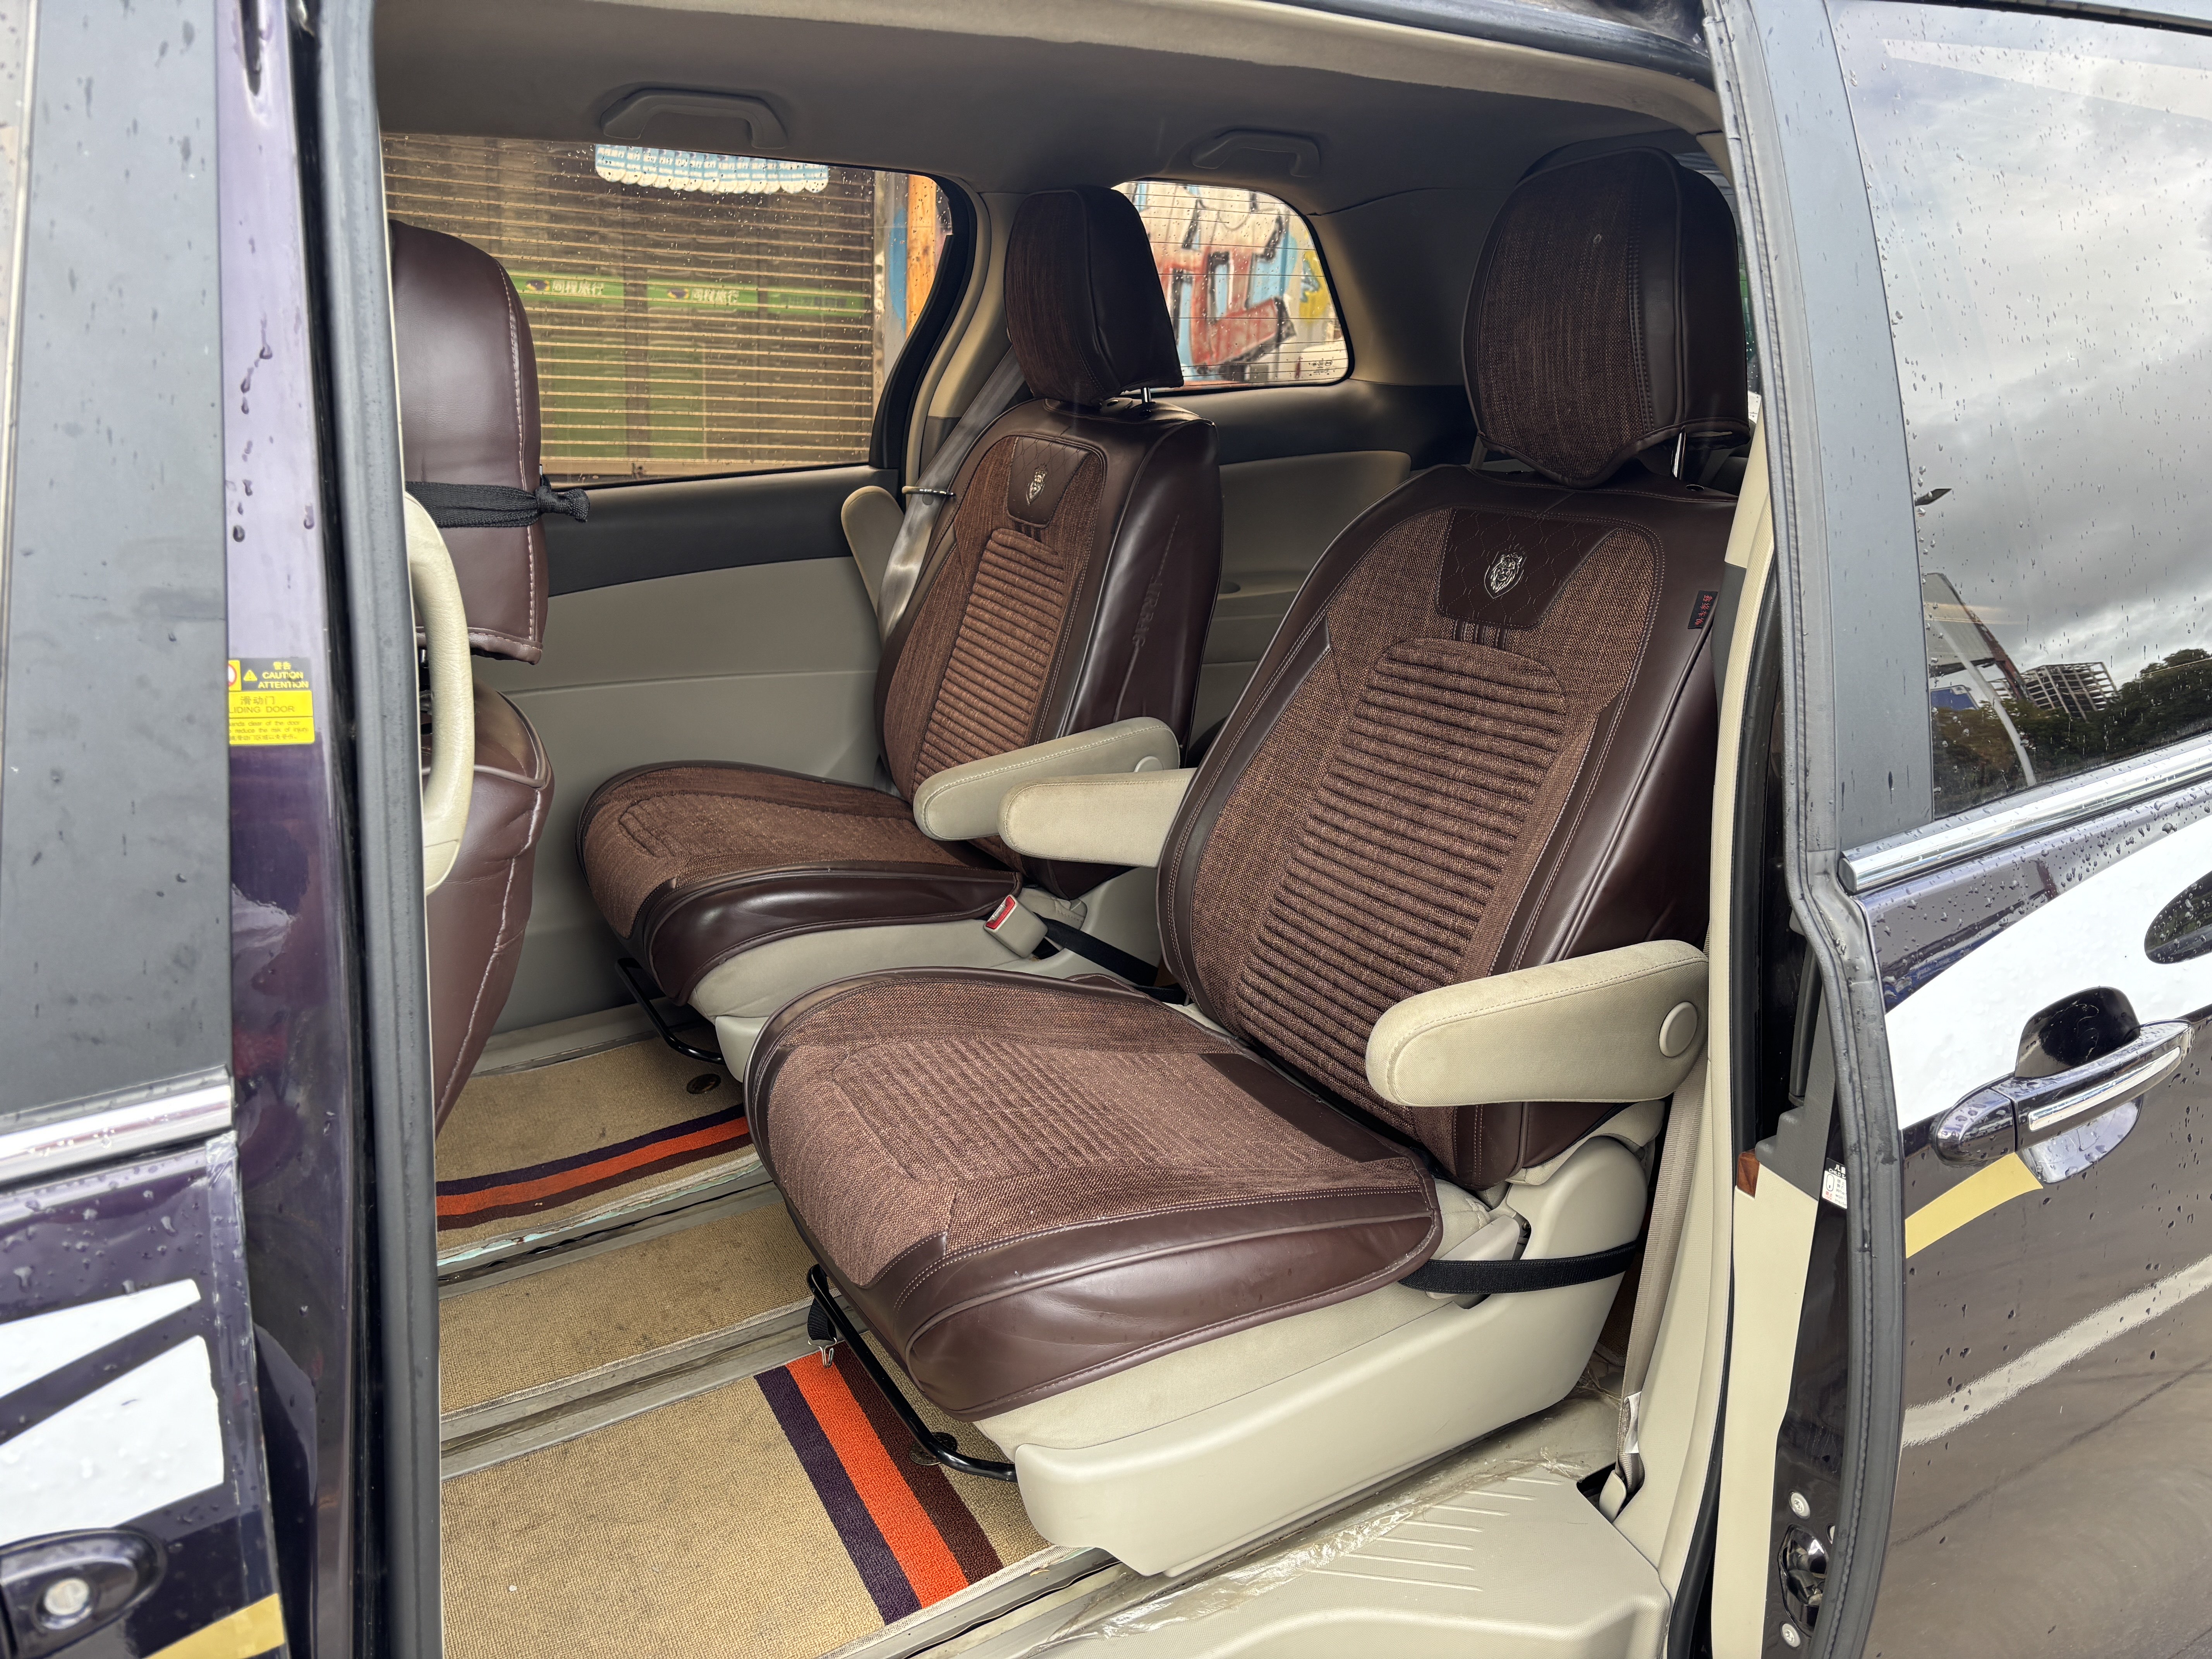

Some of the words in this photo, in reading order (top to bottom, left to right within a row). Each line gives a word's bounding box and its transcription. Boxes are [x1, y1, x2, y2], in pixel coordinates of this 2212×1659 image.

[552, 279, 604, 295] 同程旅行
[692, 287, 740, 304] 同程旅行
[240, 696, 275, 705] 滑动门
[1829, 1168, 1841, 1177] CHILD
